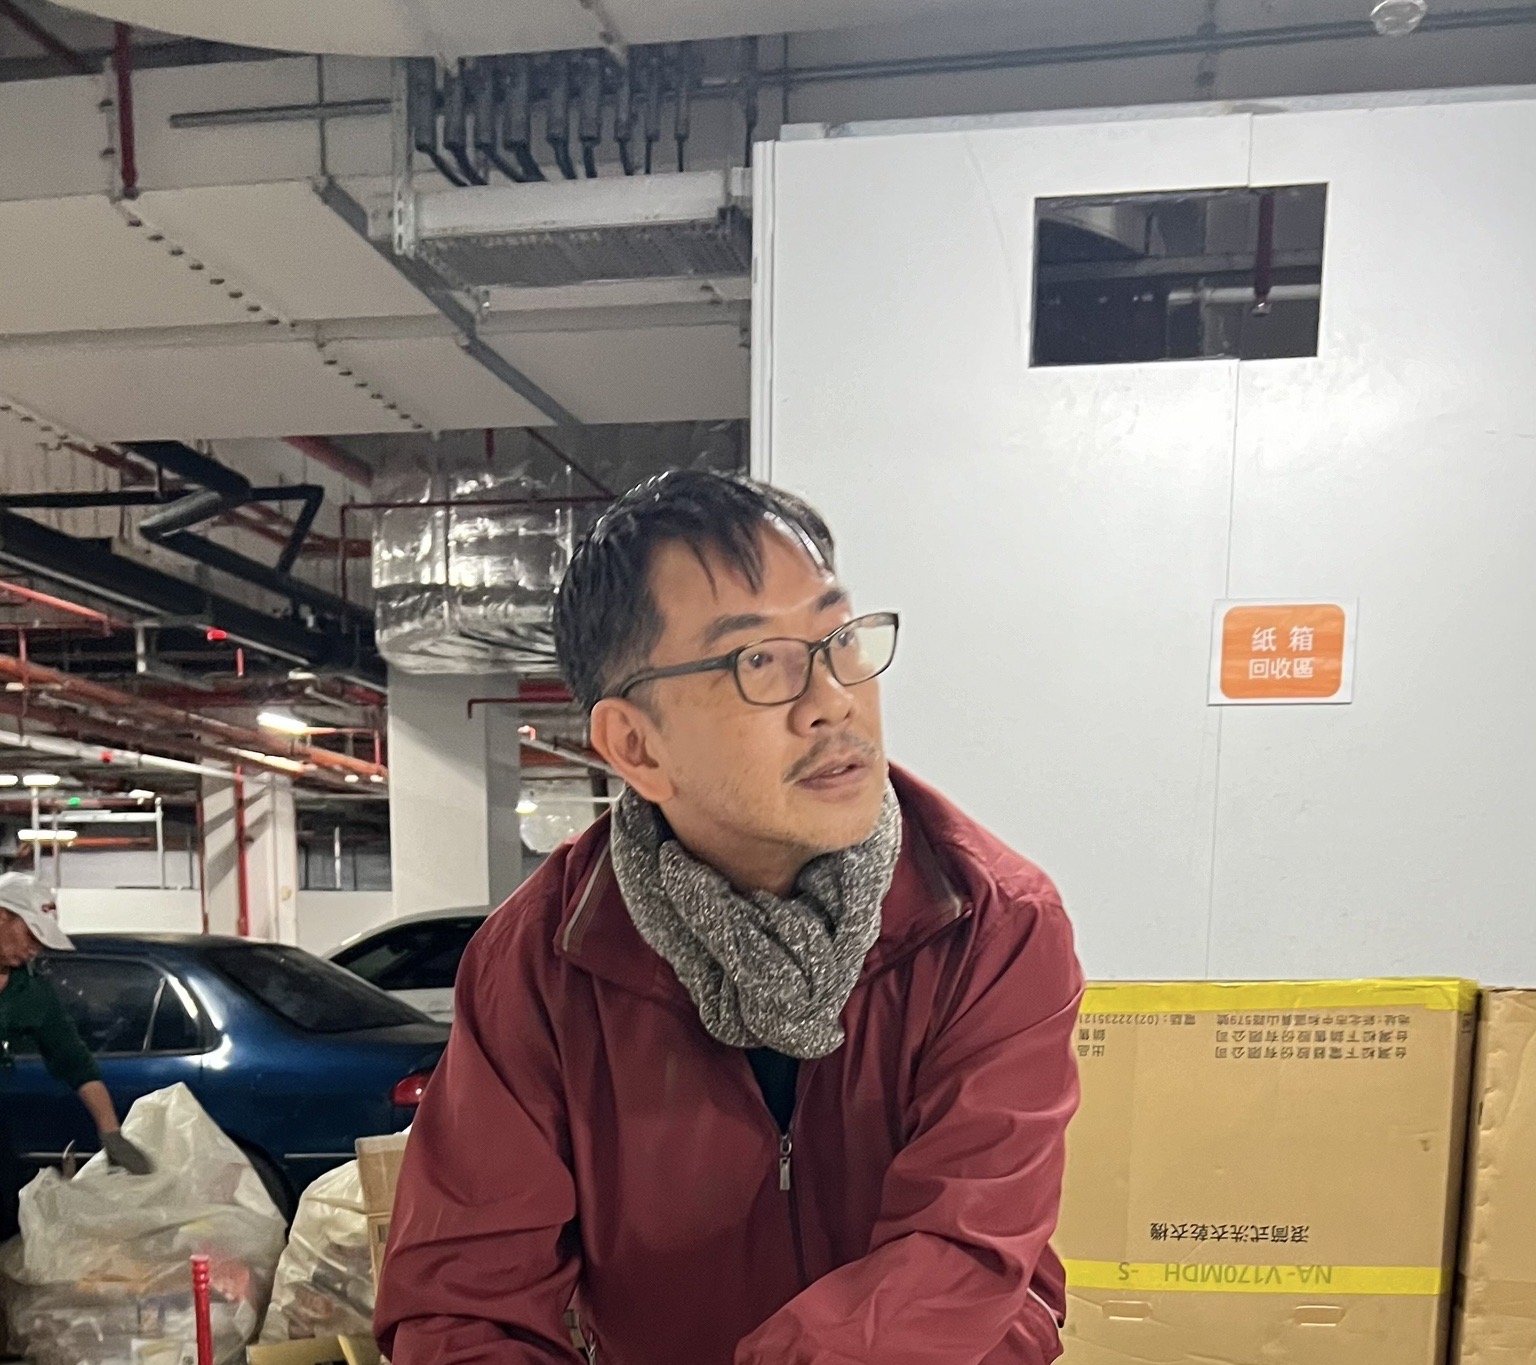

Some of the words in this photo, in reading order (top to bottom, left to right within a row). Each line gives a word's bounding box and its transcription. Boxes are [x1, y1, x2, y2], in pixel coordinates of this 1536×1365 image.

[1248, 657, 1315, 680] 回收區
[1077, 1045, 1105, 1057] 出品
[1150, 1223, 1309, 1244] 滾筒式洗衣乾衣機
